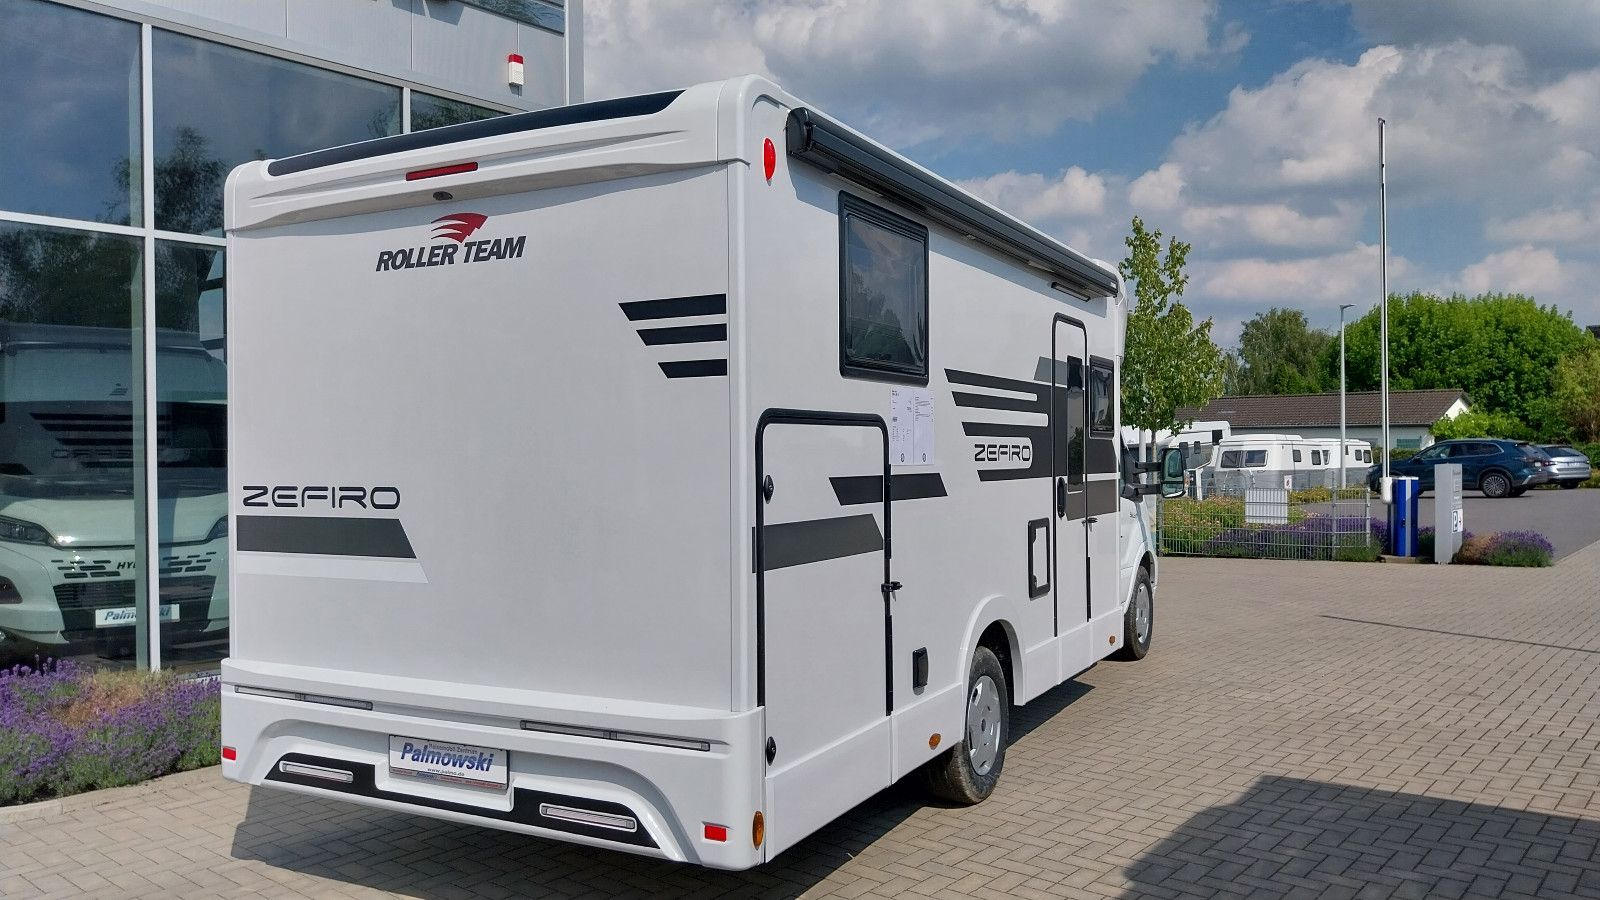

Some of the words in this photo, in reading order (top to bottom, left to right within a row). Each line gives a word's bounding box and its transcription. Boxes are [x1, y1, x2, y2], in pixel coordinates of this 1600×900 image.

[375, 243, 459, 272] ROLLER
[463, 235, 527, 263] TEAM
[974, 443, 1031, 462] ZEFIRO
[242, 485, 401, 510] ZEFIRO
[400, 741, 495, 772] Palmowski
